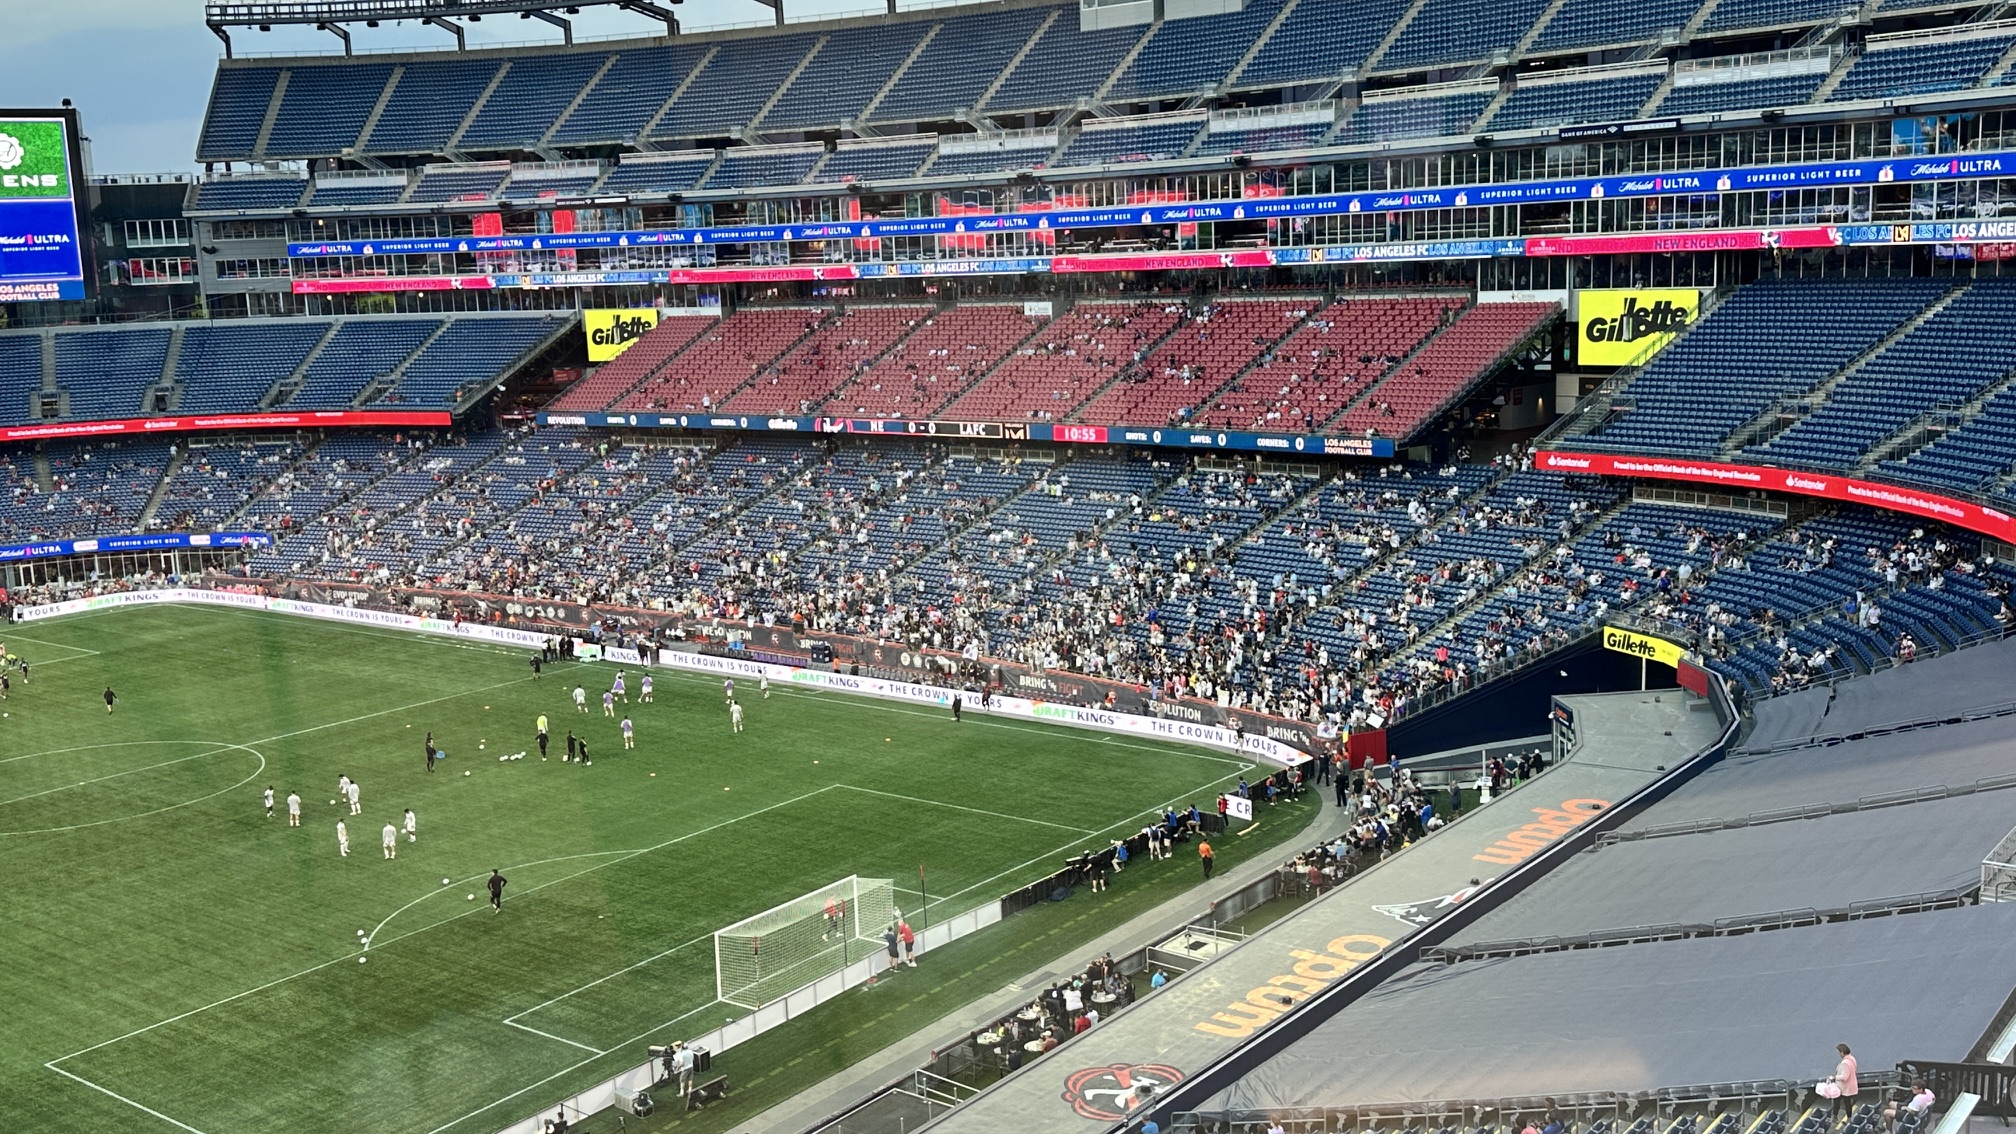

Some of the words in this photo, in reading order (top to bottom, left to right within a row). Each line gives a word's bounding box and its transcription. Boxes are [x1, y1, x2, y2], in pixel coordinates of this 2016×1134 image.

[1911, 163, 1950, 176] Michelob
[1960, 160, 2002, 172] ULTRA
[1746, 172, 1796, 182] SUPERIOR
[1800, 170, 1831, 180] LIGHT
[1835, 169, 1861, 177] BEER
[1619, 181, 1654, 192] Michelob
[1663, 178, 1700, 189] ULTRA
[1480, 190, 1522, 199] SUPERIOR
[1526, 188, 1551, 196] LIGHT
[1555, 186, 1577, 194] BEER
[1410, 194, 1441, 205] ULTRA
[1195, 208, 1222, 217] ULTRA
[1255, 204, 1291, 212] SUPERIOR
[1293, 202, 1315, 210] LIGHT
[1318, 201, 1337, 209] BEER
[1003, 218, 1028, 226] ULTRA
[1093, 214, 1112, 222] LIGHT
[828, 227, 852, 235] ULTRA
[1952, 224, 1976, 237] LOS
[1978, 222, 2016, 236] ANGE
[34, 234, 70, 244] ULTRA
[502, 239, 524, 247] ULTRA
[662, 233, 685, 241] ULTRA
[1655, 240, 1680, 249] NEW
[1683, 237, 1737, 249] ENGLAND
[327, 245, 352, 253] ULTRA
[1354, 246, 1372, 257] LOS
[1374, 245, 1416, 256] ANGELES
[1417, 245, 1428, 255] FC
[921, 264, 935, 272] LOS
[936, 262, 968, 272] ANGELES
[969, 262, 979, 271] FC
[1146, 260, 1164, 268] NEW
[1166, 258, 1204, 267] ENGLAND
[566, 274, 596, 282] ANGELES
[597, 273, 605, 282] FC
[751, 272, 766, 280] NEW
[768, 272, 800, 280] ENGLAND
[14, 283, 60, 293] ANGELES
[1586, 298, 1688, 342] Gillette
[592, 315, 652, 345] Gillette
[547, 416, 585, 424] REVOLUTION
[630, 414, 637, 426] 0
[680, 416, 688, 427] 0
[741, 417, 747, 428] 0
[870, 421, 884, 432] NE
[908, 422, 916, 433] 0
[928, 422, 936, 434] 0
[959, 423, 986, 435] LAFC
[1064, 428, 1096, 440] 10:55
[1153, 430, 1161, 443] 0
[1218, 434, 1226, 446] 0
[1257, 438, 1289, 447] CORNERS:
[1295, 437, 1304, 450] 0
[1339, 440, 1372, 448] ANGELES
[1325, 447, 1355, 455] FOOTBALL
[1556, 457, 1591, 468] Santander
[1614, 461, 1630, 469] Proud
[1653, 464, 1672, 472] Official
[1692, 467, 1701, 475] the
[1701, 468, 1713, 476] New
[1713, 469, 1733, 479] England
[1734, 471, 1760, 480] Revolution
[1794, 478, 1827, 490] Santander
[1848, 485, 1862, 495] Proud
[32, 545, 61, 555] ULTRA
[188, 591, 200, 600] THE
[202, 593, 225, 601] CROWN
[237, 596, 256, 604] YOURS
[28, 605, 61, 617] YOURS
[332, 608, 344, 616] THE
[346, 610, 370, 619] CROWN
[381, 614, 402, 624] YOURS
[491, 629, 504, 638] THE
[507, 631, 534, 642] CROWN
[537, 635, 544, 643] IS
[1607, 633, 1656, 657] Gillette
[673, 654, 688, 664] THE
[692, 656, 723, 668] CROWN
[727, 661, 735, 670] IS
[738, 663, 767, 674] YOURS
[792, 672, 859, 688] DRAFTKINGS
[1020, 675, 1046, 689] BRING
[890, 684, 907, 694] THE
[912, 687, 949, 700] CROWN
[967, 695, 1002, 708] YORS
[1033, 705, 1115, 725] DRAFTKINGS
[1152, 721, 1173, 733] THE
[1179, 726, 1223, 742] CROWN
[1229, 734, 1238, 743] IS
[1267, 726, 1298, 742] BRING
[1299, 731, 1310, 746] THE
[1472, 798, 1612, 864] Optum
[1192, 934, 1393, 1038] Optum
